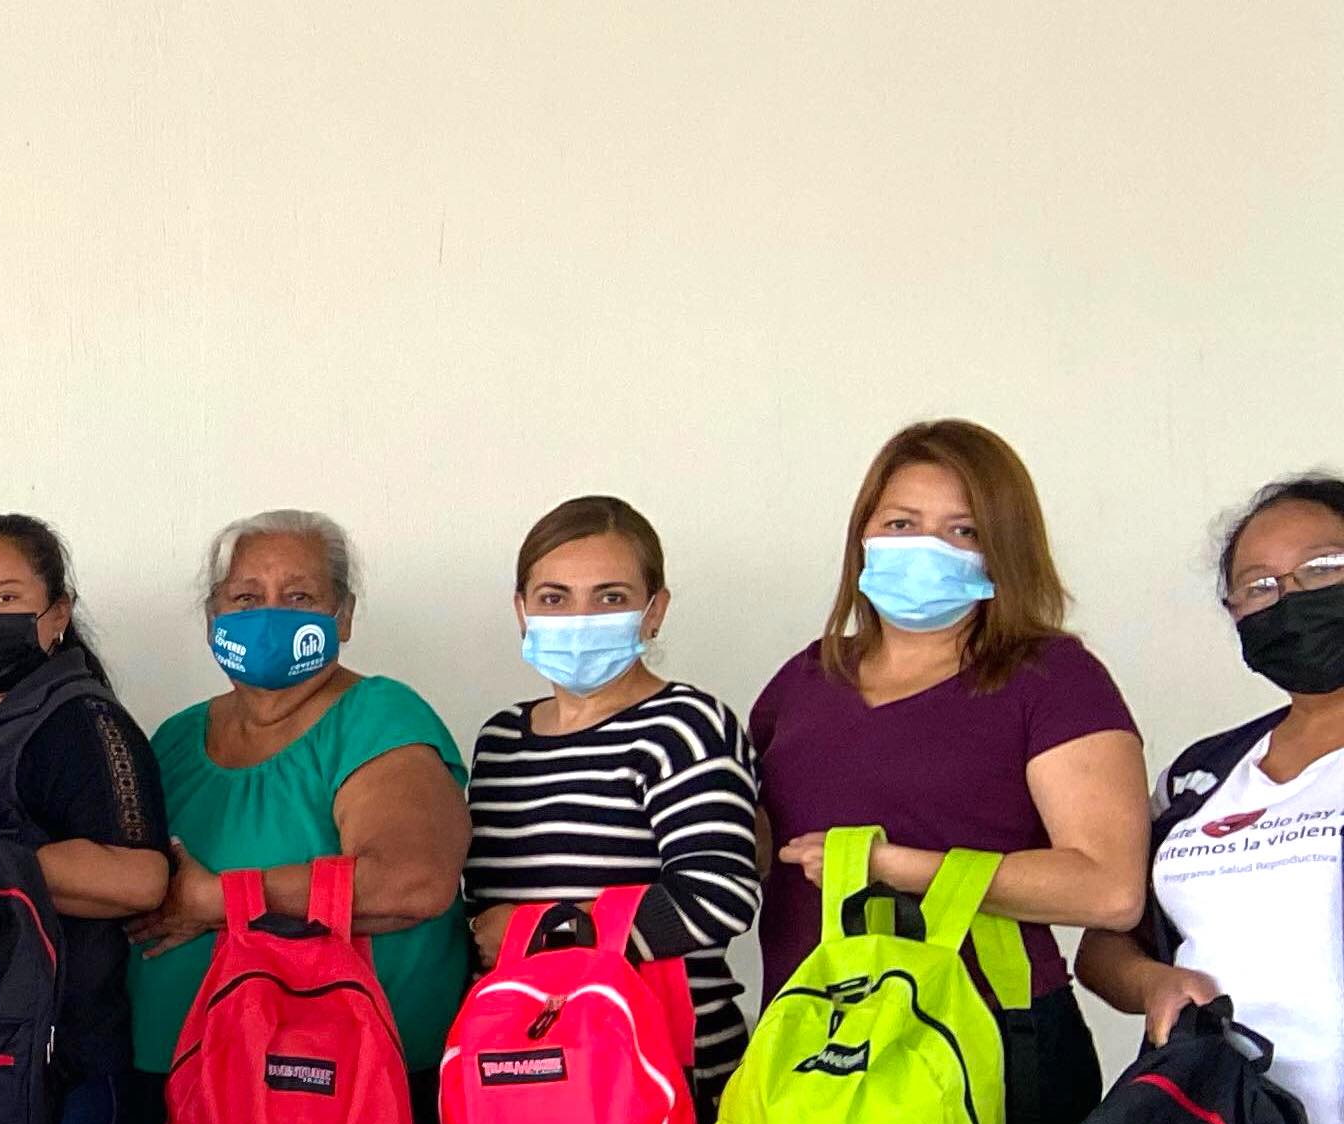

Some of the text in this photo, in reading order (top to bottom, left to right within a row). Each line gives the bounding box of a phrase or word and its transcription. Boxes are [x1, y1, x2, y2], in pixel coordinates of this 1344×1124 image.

[215, 635, 247, 656] COVERED
[1249, 815, 1293, 831] solo
[1296, 808, 1335, 823] hay
[1158, 824, 1344, 862] vitemos la violen
[1219, 863, 1253, 875] Salud
[1255, 852, 1337, 872] Reproductiva
